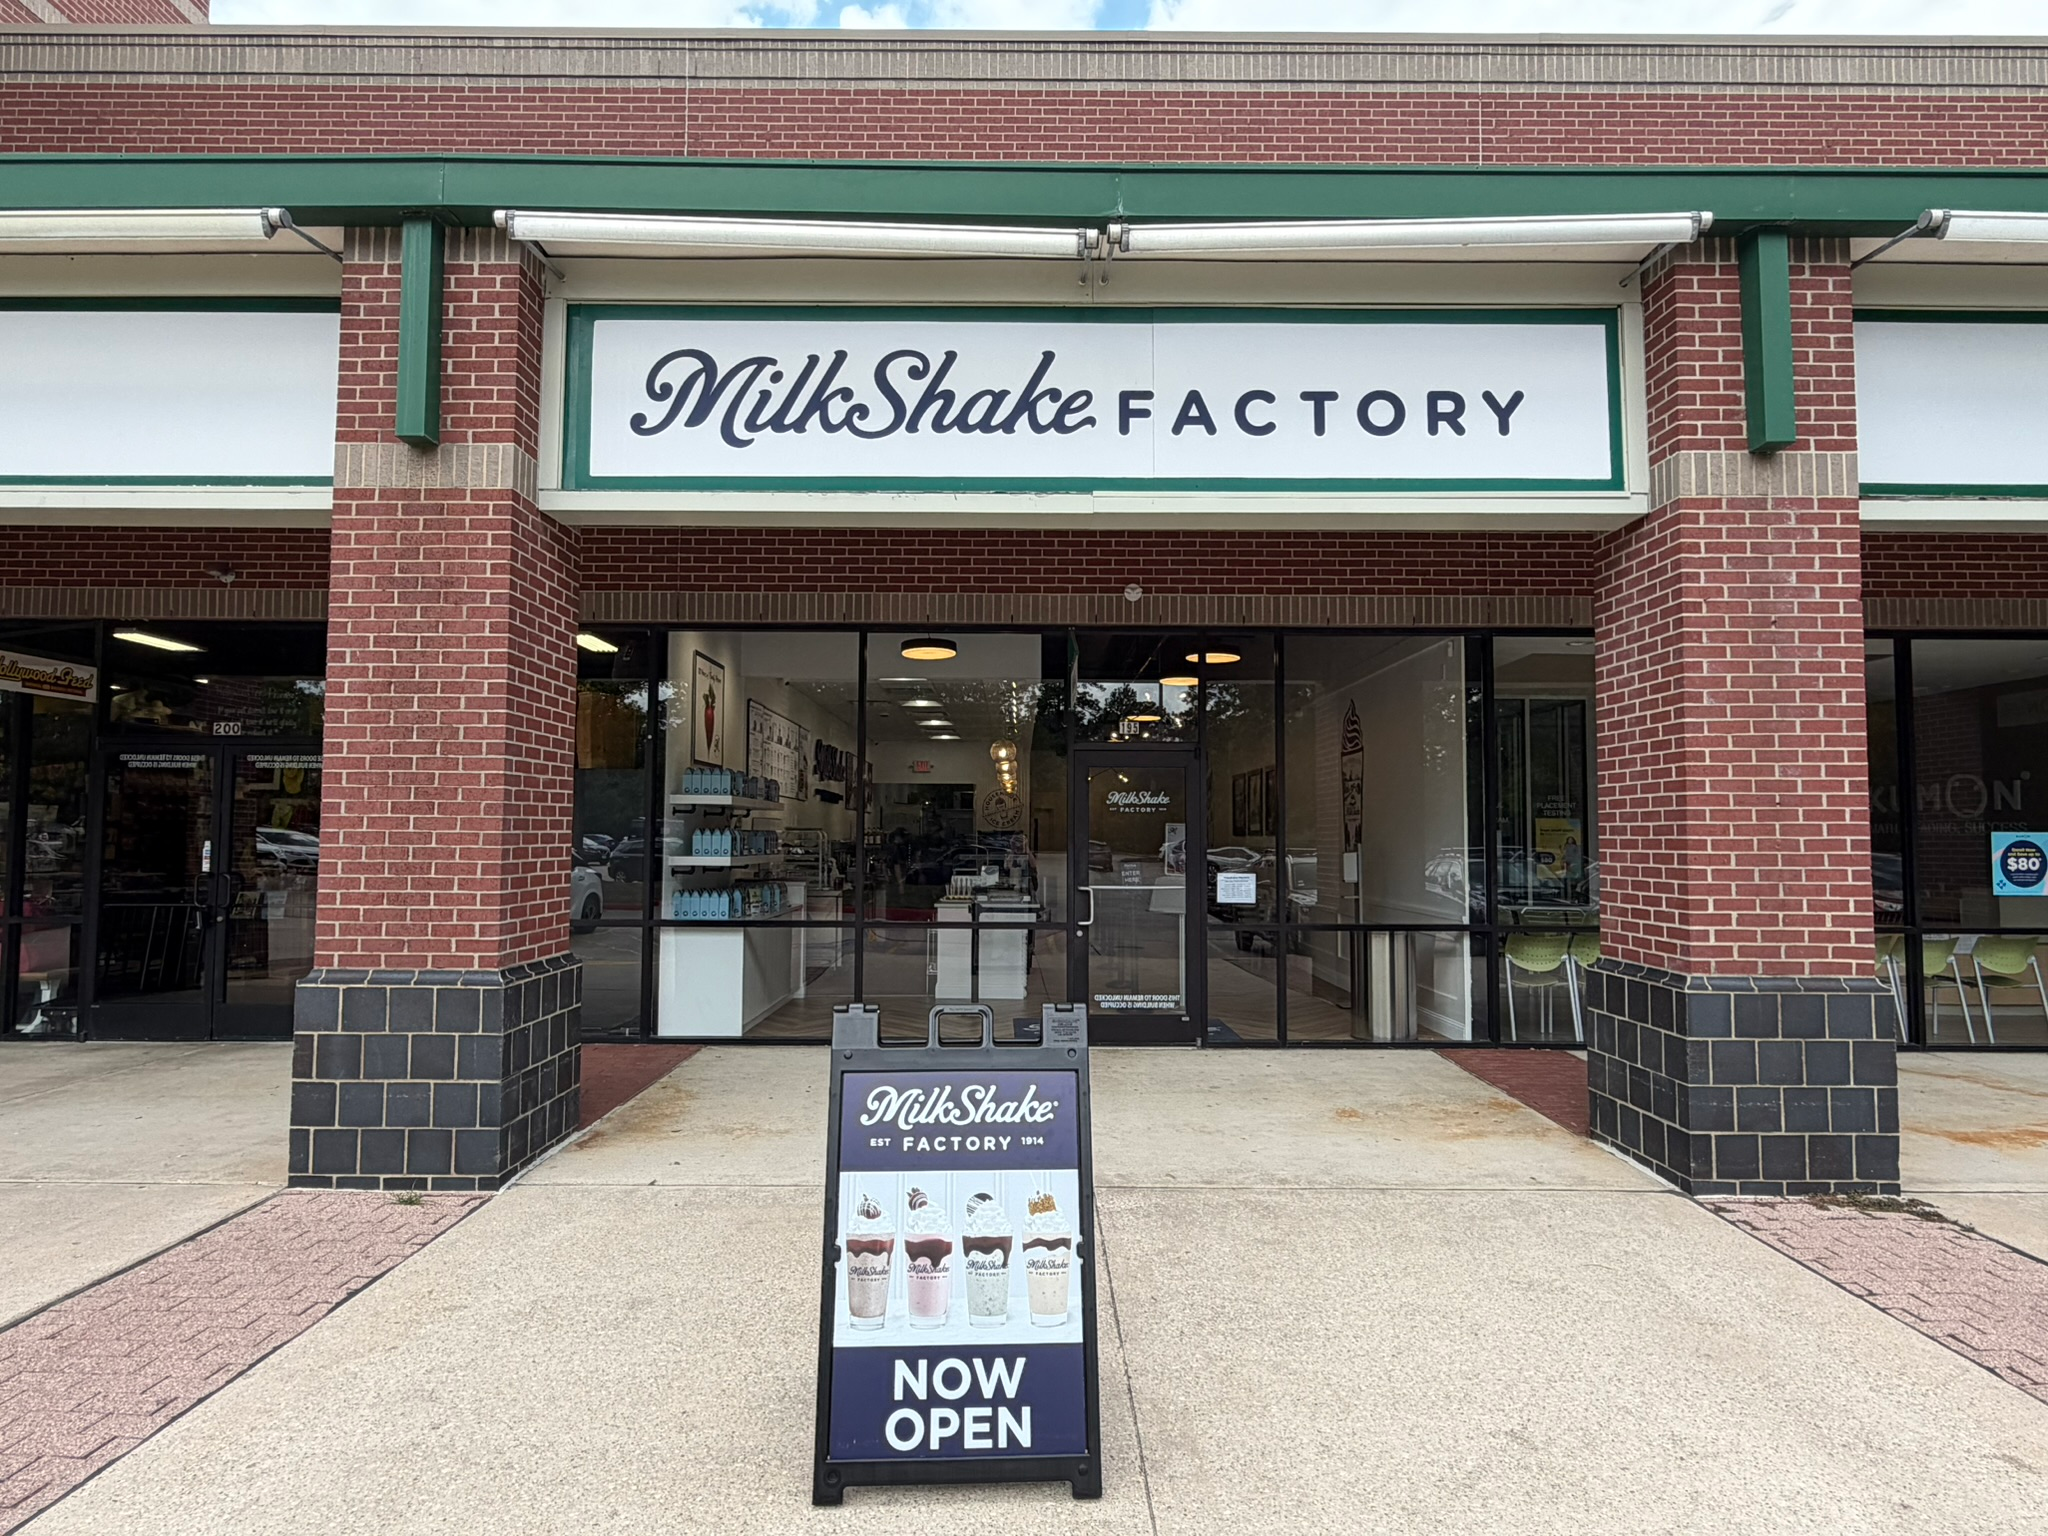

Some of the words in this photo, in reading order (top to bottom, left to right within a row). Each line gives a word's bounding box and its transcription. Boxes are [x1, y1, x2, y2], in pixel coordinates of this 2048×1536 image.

[629, 348, 1097, 448] MilkShake
[1118, 389, 1525, 437] FACTORY
[0, 655, 58, 682] ollywood
[57, 667, 94, 689] Feed
[214, 723, 240, 734] 200
[1121, 722, 1138, 734] 195
[1106, 791, 1170, 806] MilkShake
[859, 1084, 1057, 1131] MilkShake
[870, 1138, 891, 1147] EST
[903, 1136, 1012, 1152] FACTORY
[1021, 1136, 1044, 1146] 1914
[893, 1357, 1027, 1401] NOW
[885, 1406, 1033, 1452] OPEN
